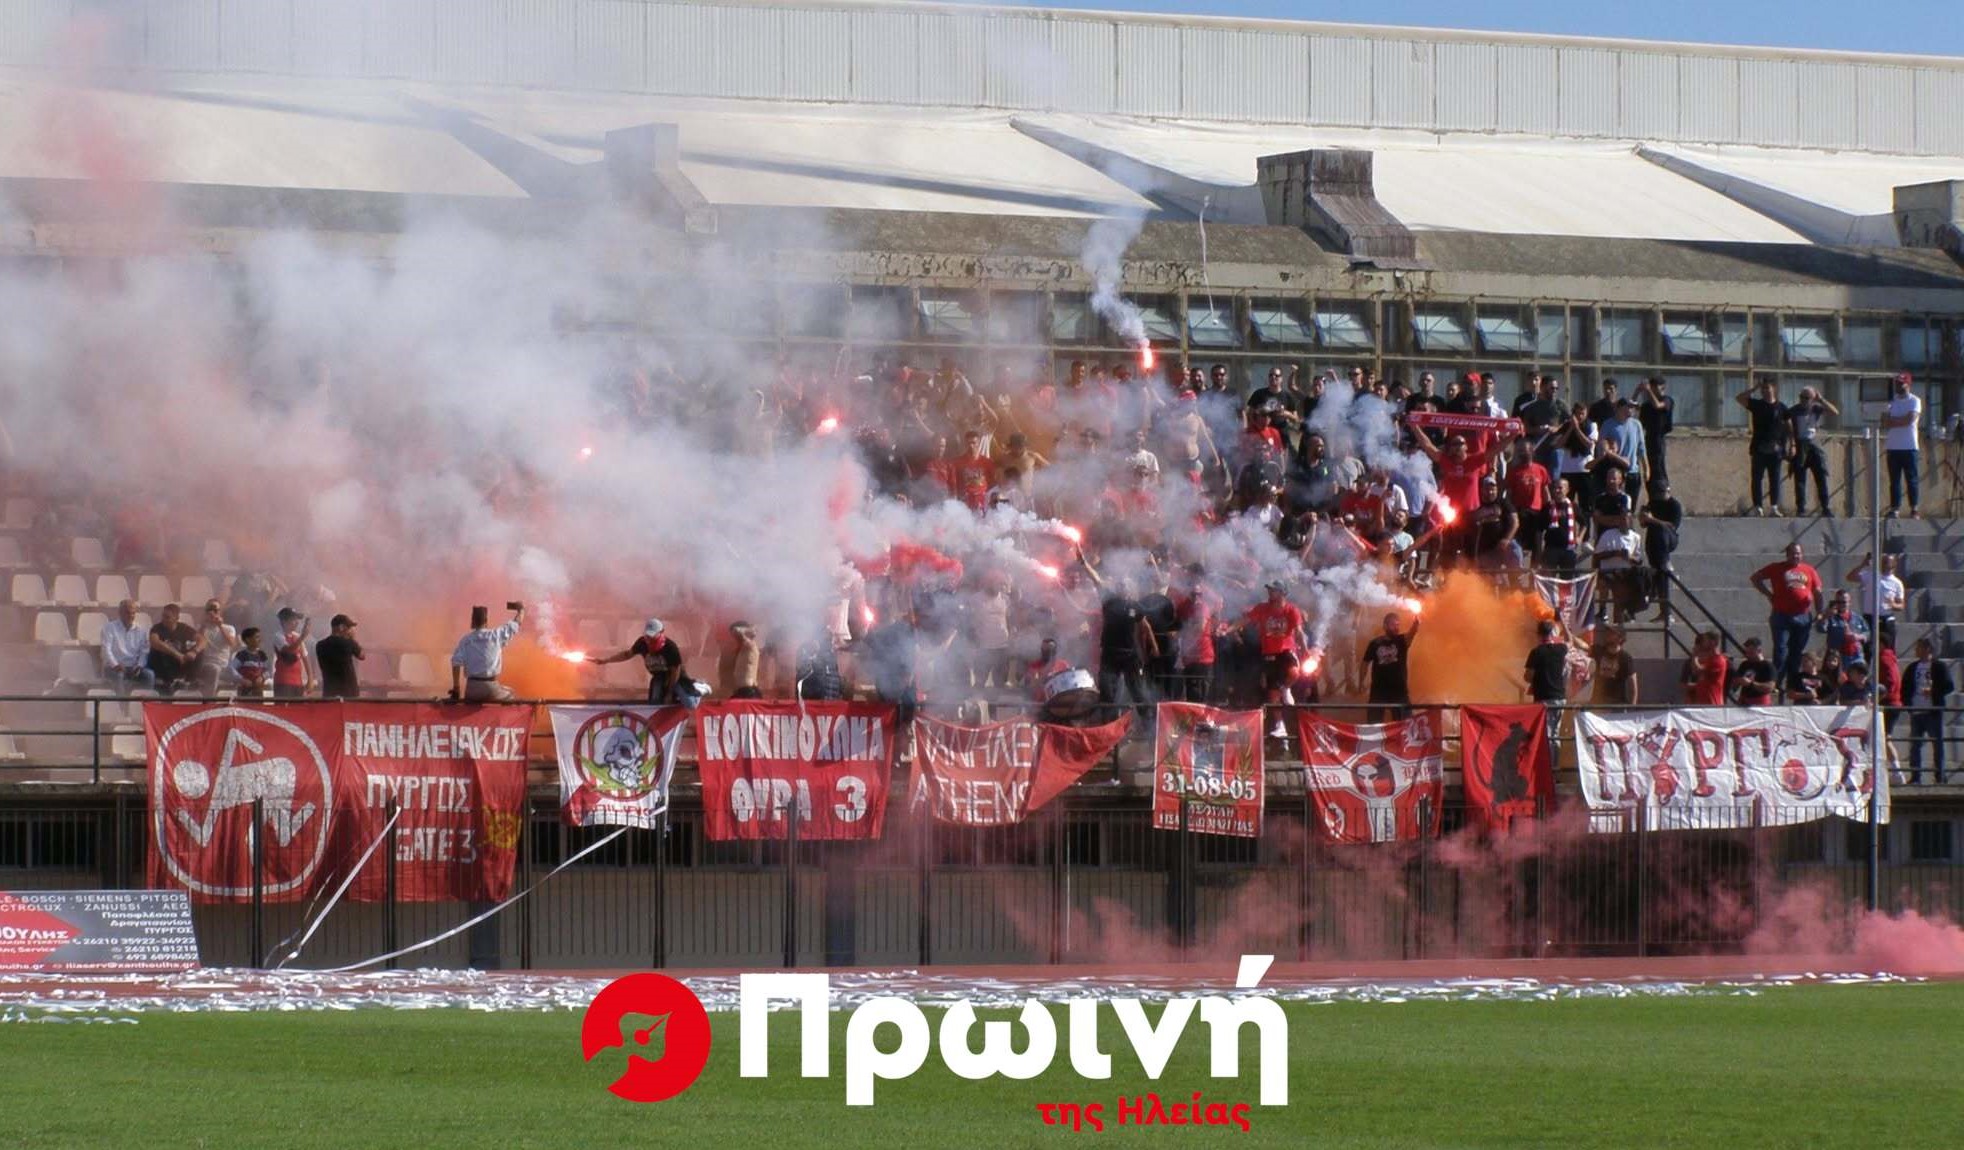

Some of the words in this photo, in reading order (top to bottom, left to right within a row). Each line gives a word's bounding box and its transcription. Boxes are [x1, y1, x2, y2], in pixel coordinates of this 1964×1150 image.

[344, 721, 526, 761] ΠΑΝΗΛΕΙΑΚΟΣ
[367, 774, 471, 814] ΠΥΡΓΟΣ
[1162, 772, 1256, 801] 31-08-05
[731, 777, 812, 823] ΘΥΡΑ
[835, 775, 867, 823] 3
[76, 895, 131, 903] SIEMENS
[141, 894, 187, 902] PITSOS
[84, 903, 140, 911] ZANUSSI
[0, 926, 69, 939] ΟΥΛΗΣ
[83, 937, 118, 945] 26210
